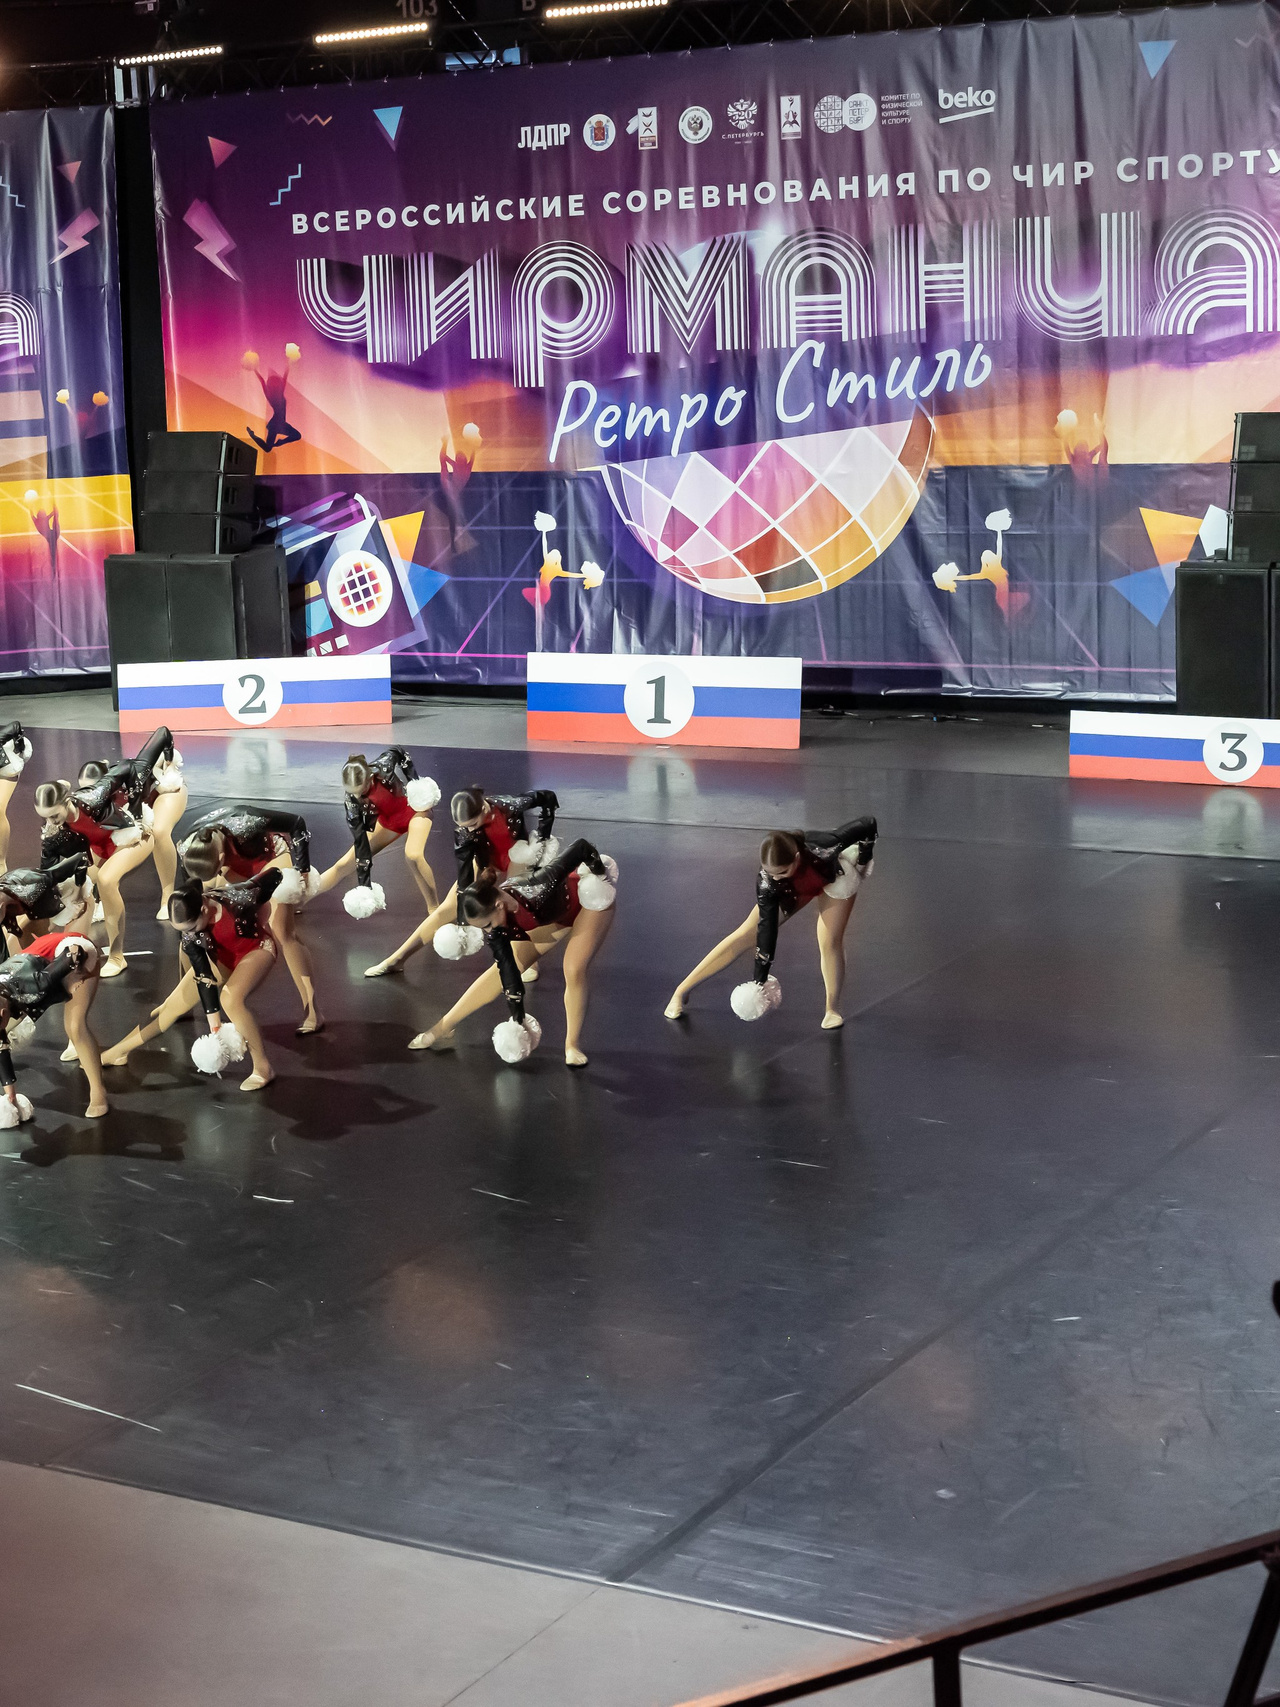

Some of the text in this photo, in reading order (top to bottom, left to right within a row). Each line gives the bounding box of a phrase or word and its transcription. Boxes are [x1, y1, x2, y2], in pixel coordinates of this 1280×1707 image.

[881, 92, 921, 102] КОМИТЕТ ПО
[881, 99, 923, 110] ФИЗИЧЕСКОЙ
[938, 86, 996, 110] beko
[881, 109, 910, 117] КУЛЬТУРЕ
[888, 117, 912, 125] СПОРТУ
[518, 123, 570, 151] ЛДПР
[292, 148, 1280, 235] ВСЕРОССИЙСКИЕ СОРЕВНОВАНИЯ ПО ЧИР СПОРТУ
[549, 339, 993, 463] Ретро Стиль
[238, 674, 267, 714] 2
[646, 675, 672, 724] 1
[1218, 732, 1248, 772] 3
